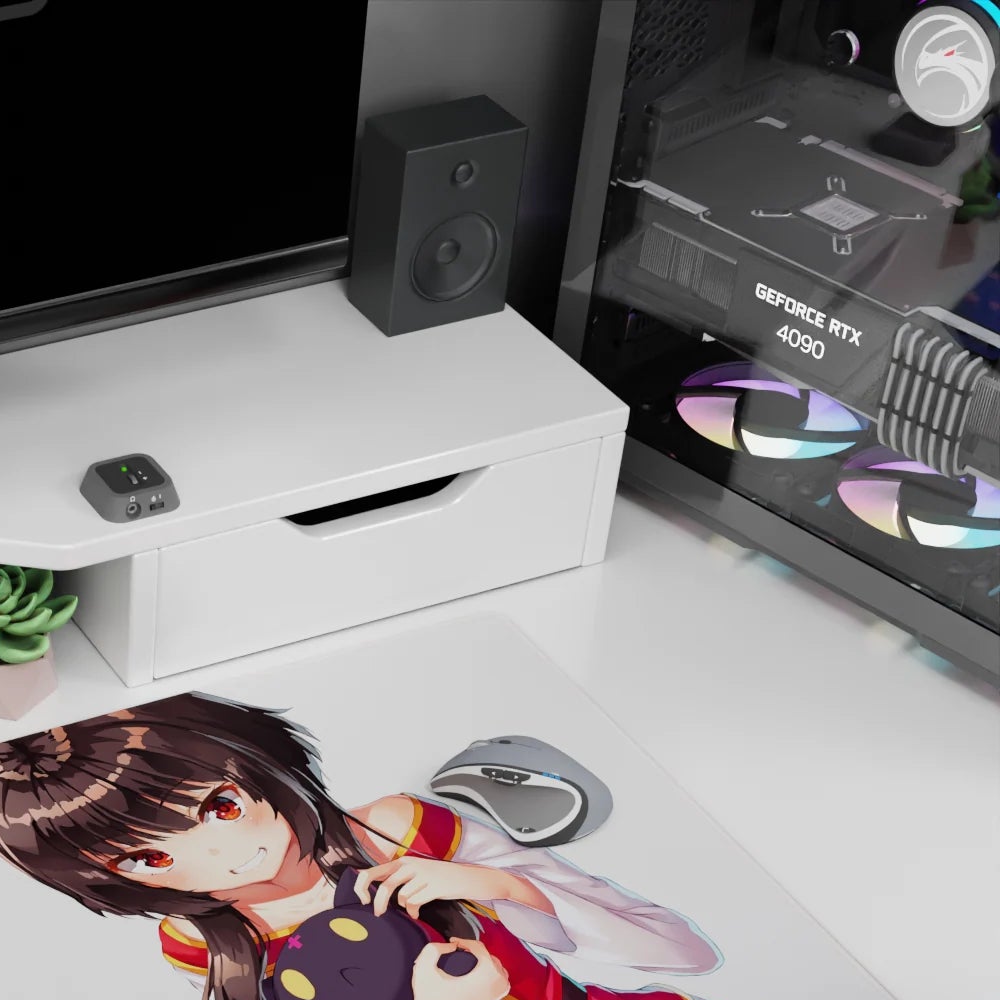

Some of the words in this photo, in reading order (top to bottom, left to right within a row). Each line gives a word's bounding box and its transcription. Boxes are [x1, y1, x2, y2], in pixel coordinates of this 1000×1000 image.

[755, 282, 826, 329] GEFORCE
[828, 317, 863, 347] RTX
[775, 324, 826, 360] 4090
